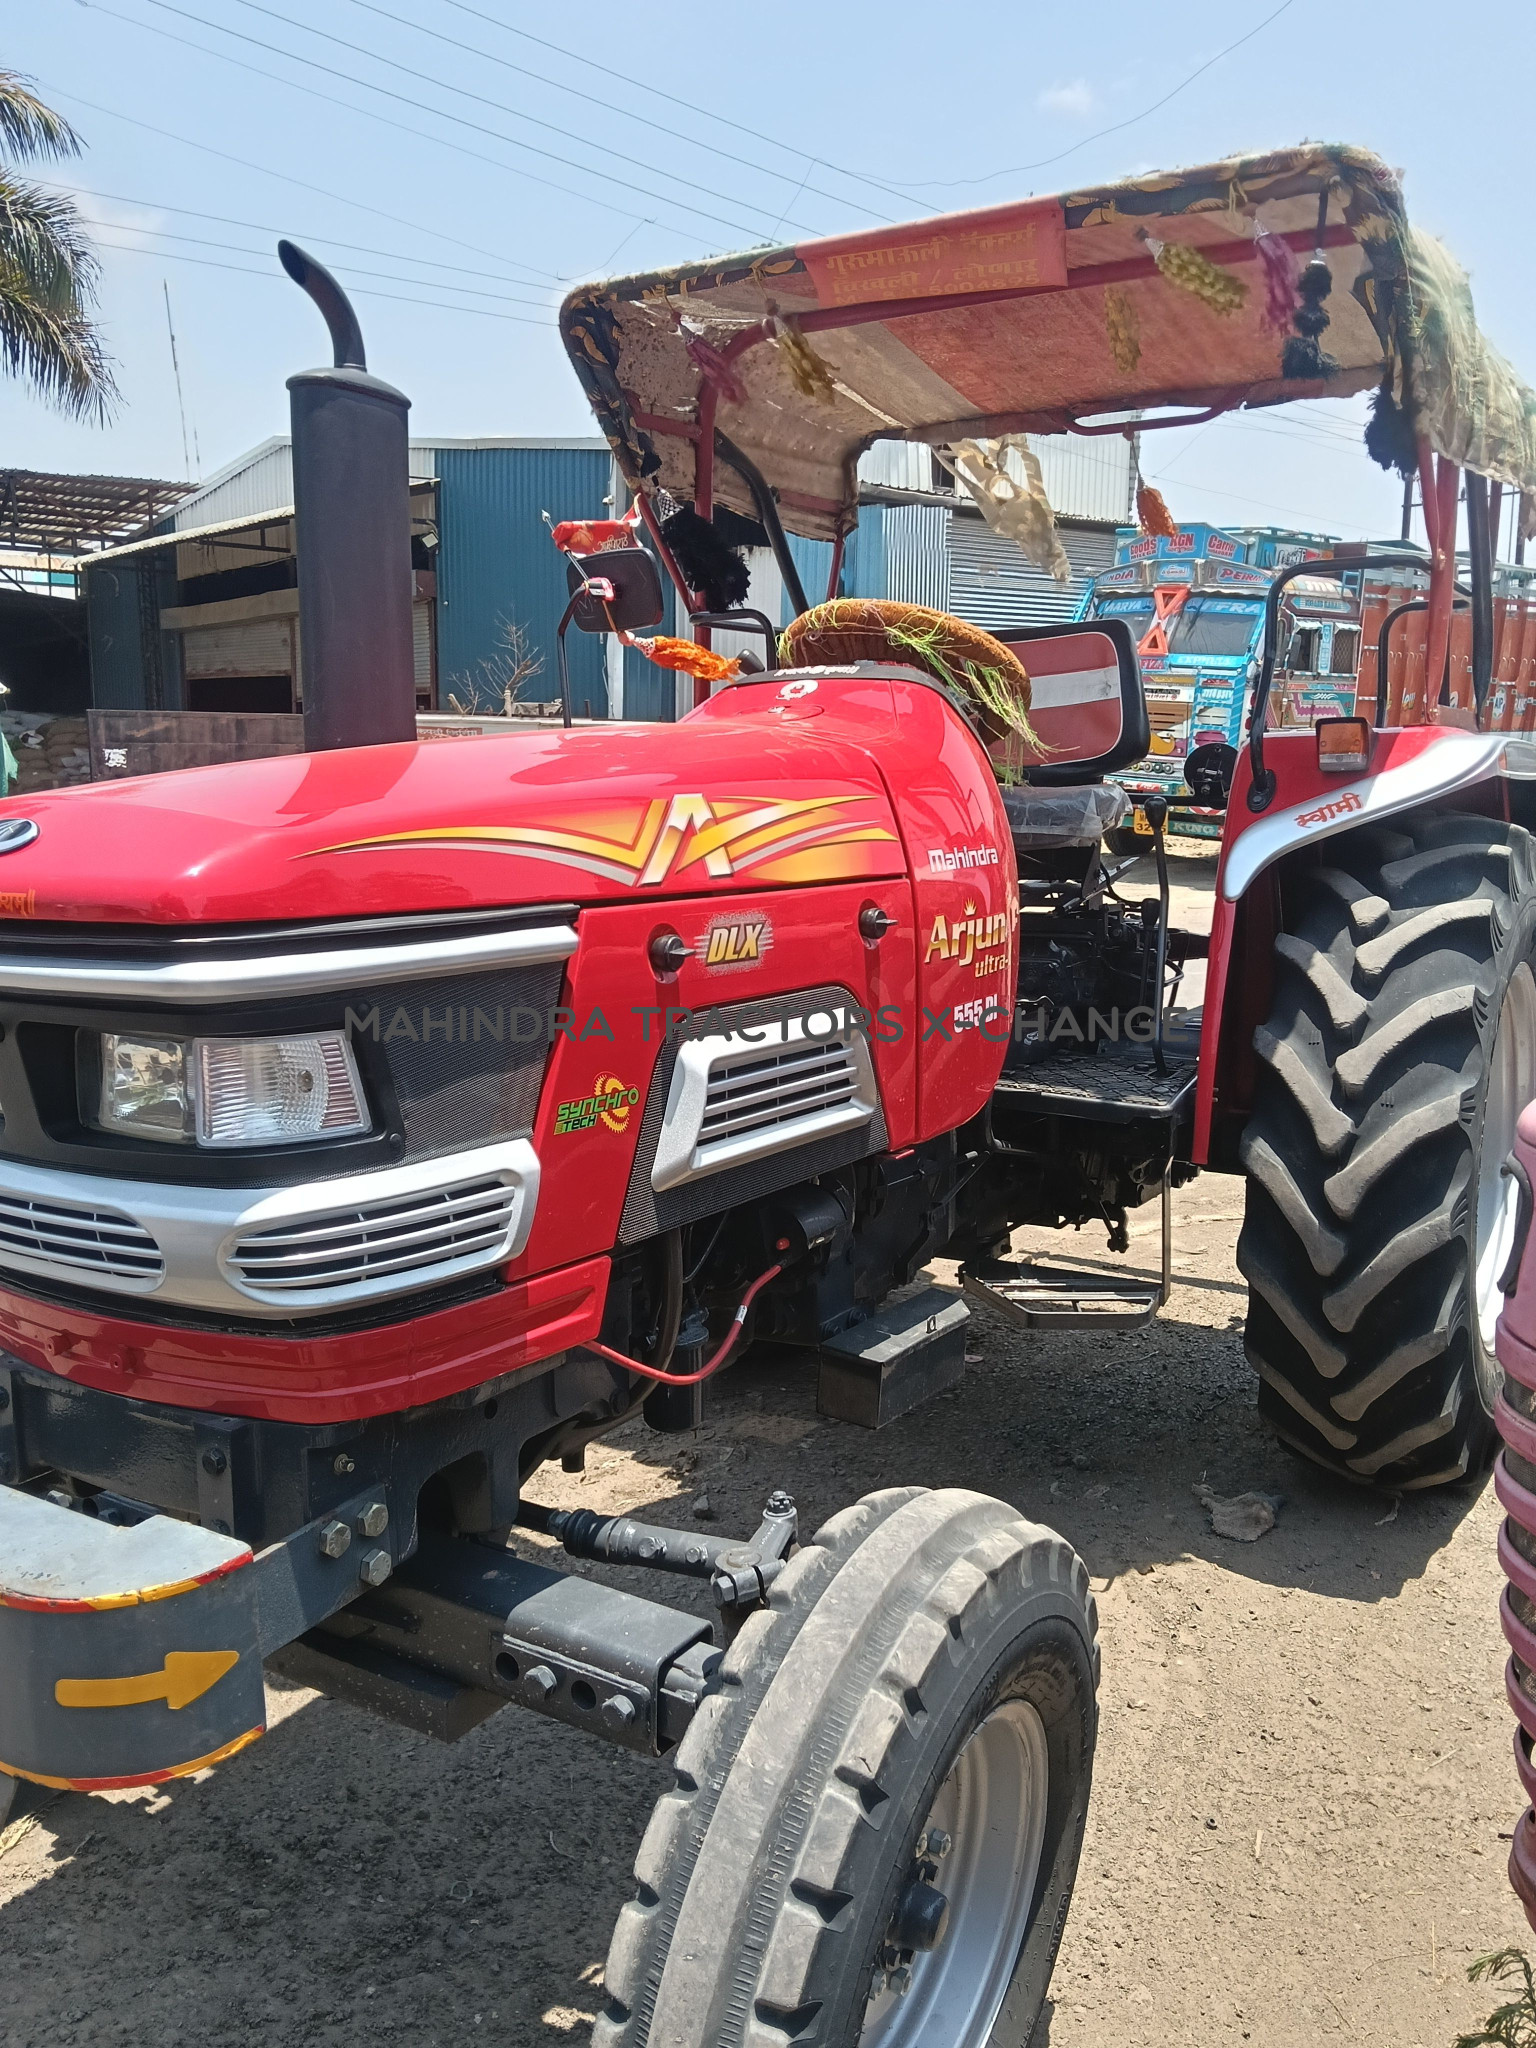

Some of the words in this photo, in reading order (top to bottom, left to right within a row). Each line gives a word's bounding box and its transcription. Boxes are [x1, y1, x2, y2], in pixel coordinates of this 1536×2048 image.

[1130, 538, 1157, 555] Goods
[1173, 822, 1215, 834] KING
[1294, 792, 1362, 828] स्वामी
[927, 844, 999, 874] Mahindra
[706, 922, 765, 966] DLX
[924, 912, 1006, 966] Arjun
[954, 998, 983, 1034] 555
[985, 993, 998, 1024] DI
